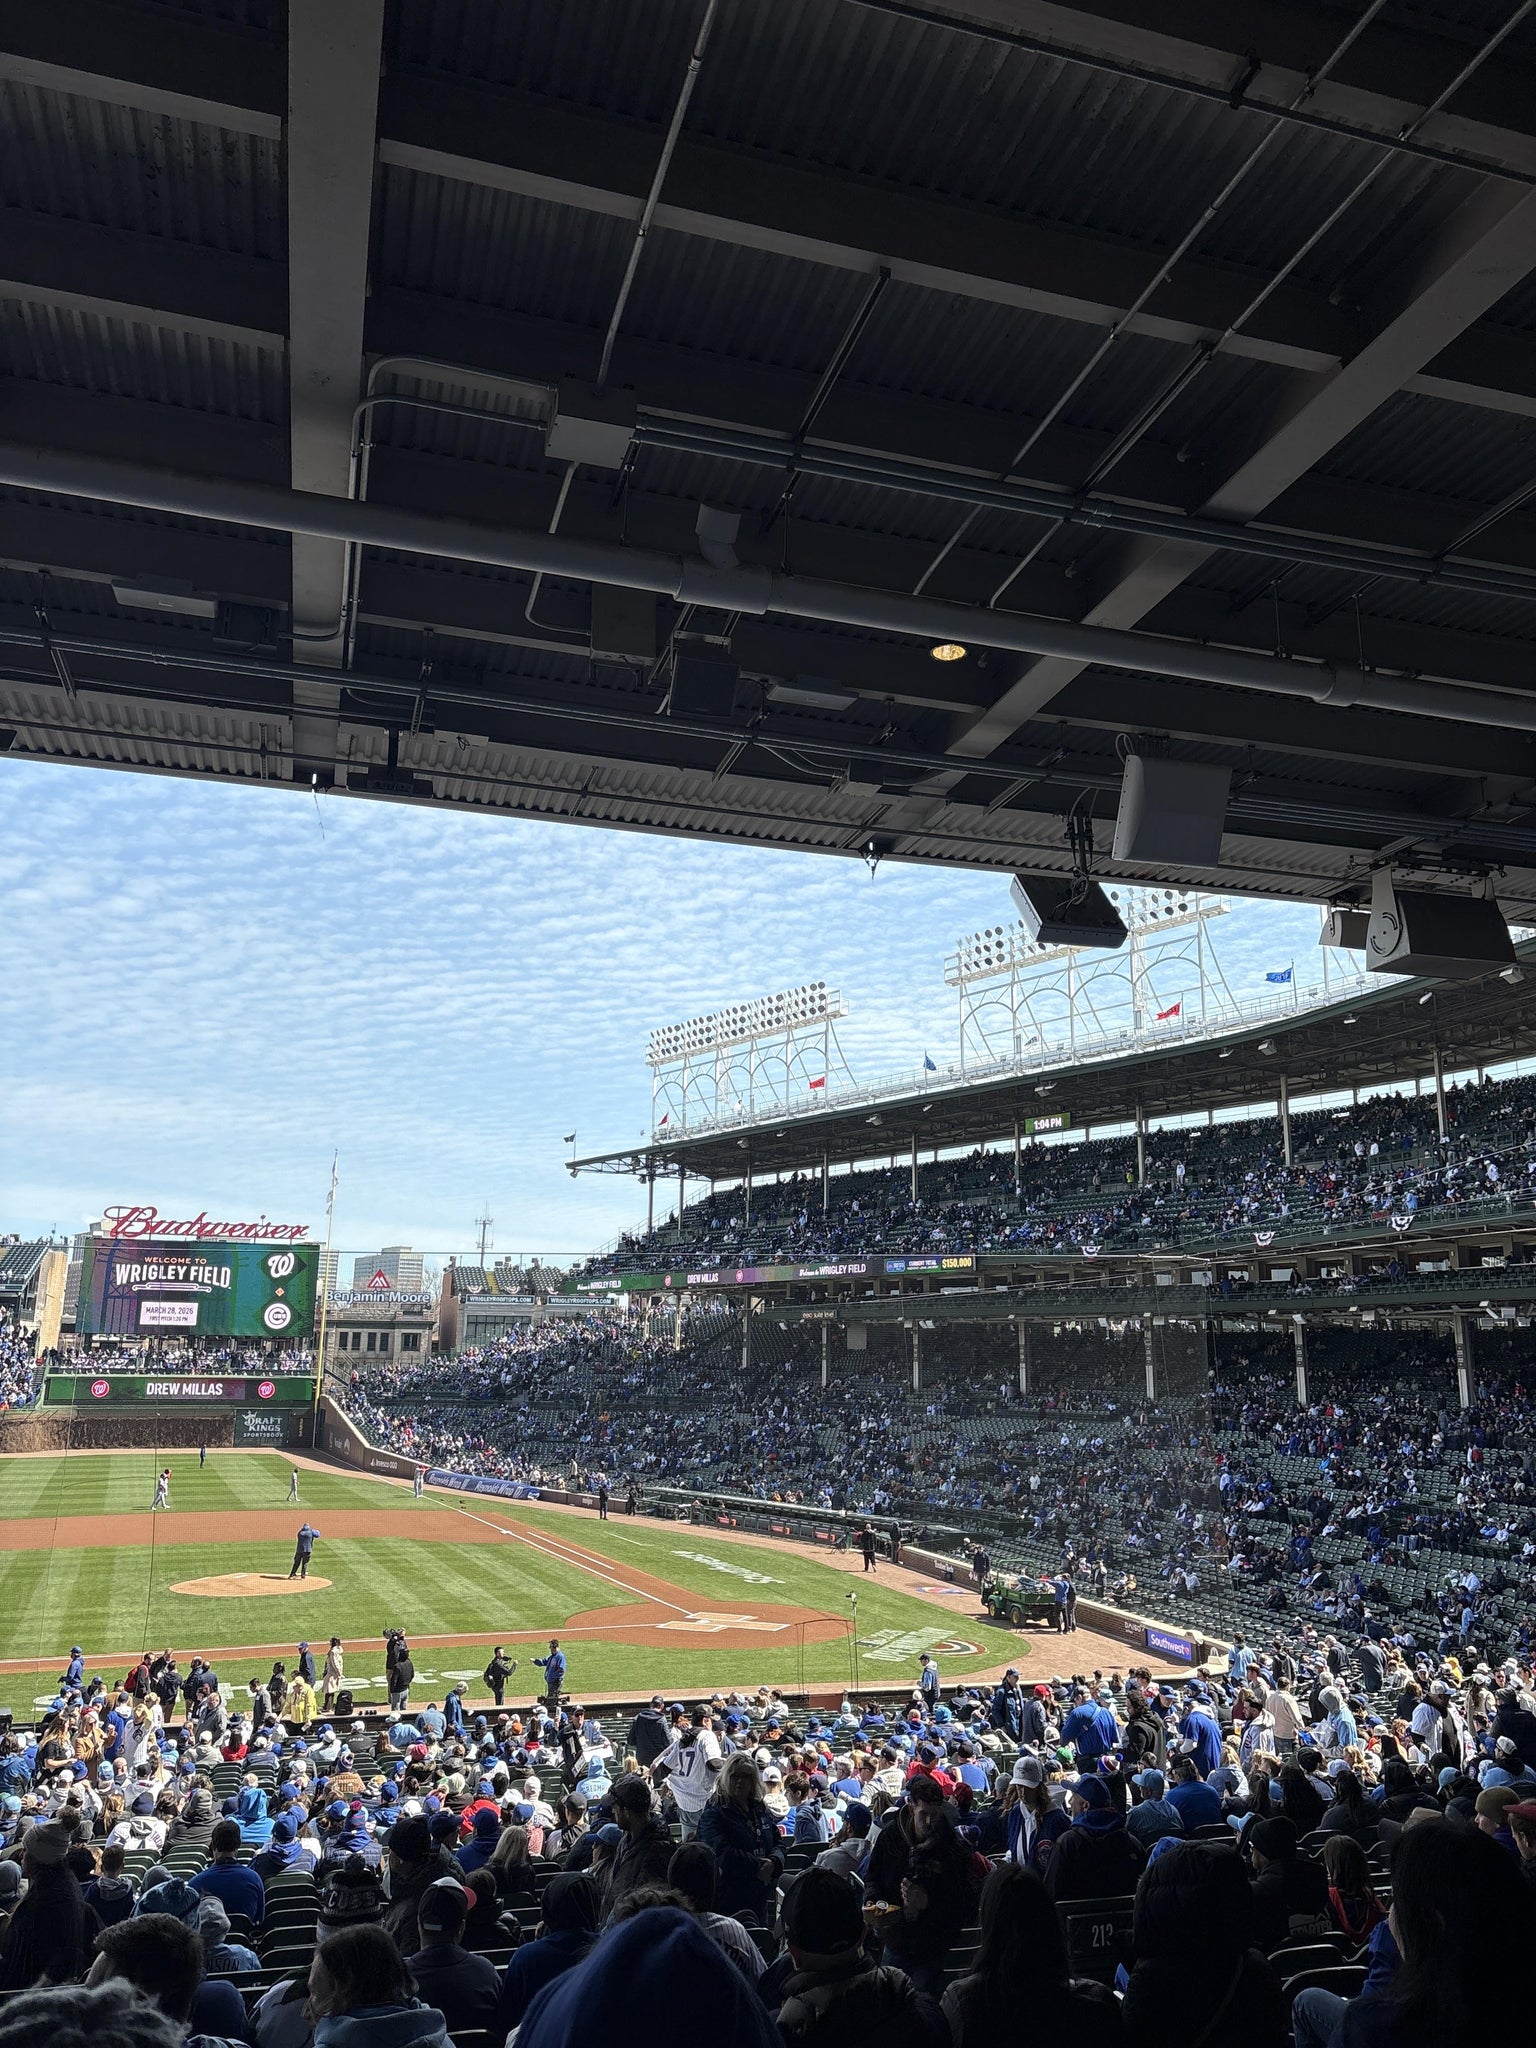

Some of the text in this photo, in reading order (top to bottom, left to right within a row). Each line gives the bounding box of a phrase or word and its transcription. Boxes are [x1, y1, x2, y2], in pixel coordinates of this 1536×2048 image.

[1034, 1117, 1062, 1130] 1:04 PM
[104, 1206, 309, 1238] Budweiser
[144, 1256, 191, 1264] WELCOME
[942, 1257, 972, 1268] $150,000
[819, 1264, 848, 1275] WRIGLEY
[848, 1263, 866, 1274] FIELD
[115, 1264, 231, 1288] WRIGLEY FIELD
[687, 1273, 718, 1284] DREW MILLAS
[609, 1280, 622, 1288] FIELD
[327, 1291, 430, 1304] Benjamin Moore
[469, 1295, 532, 1303] WRIGLEYROOFTOPS.COM
[145, 1306, 194, 1315] MARCH 28, 2026
[146, 1382, 223, 1396] DREW MILLAS
[244, 1415, 283, 1426] DRAFT
[248, 1424, 281, 1432] KINGS
[1150, 1633, 1185, 1655] Southwest
[678, 1750, 696, 1777] 17
[207, 1957, 240, 1972] NSON
